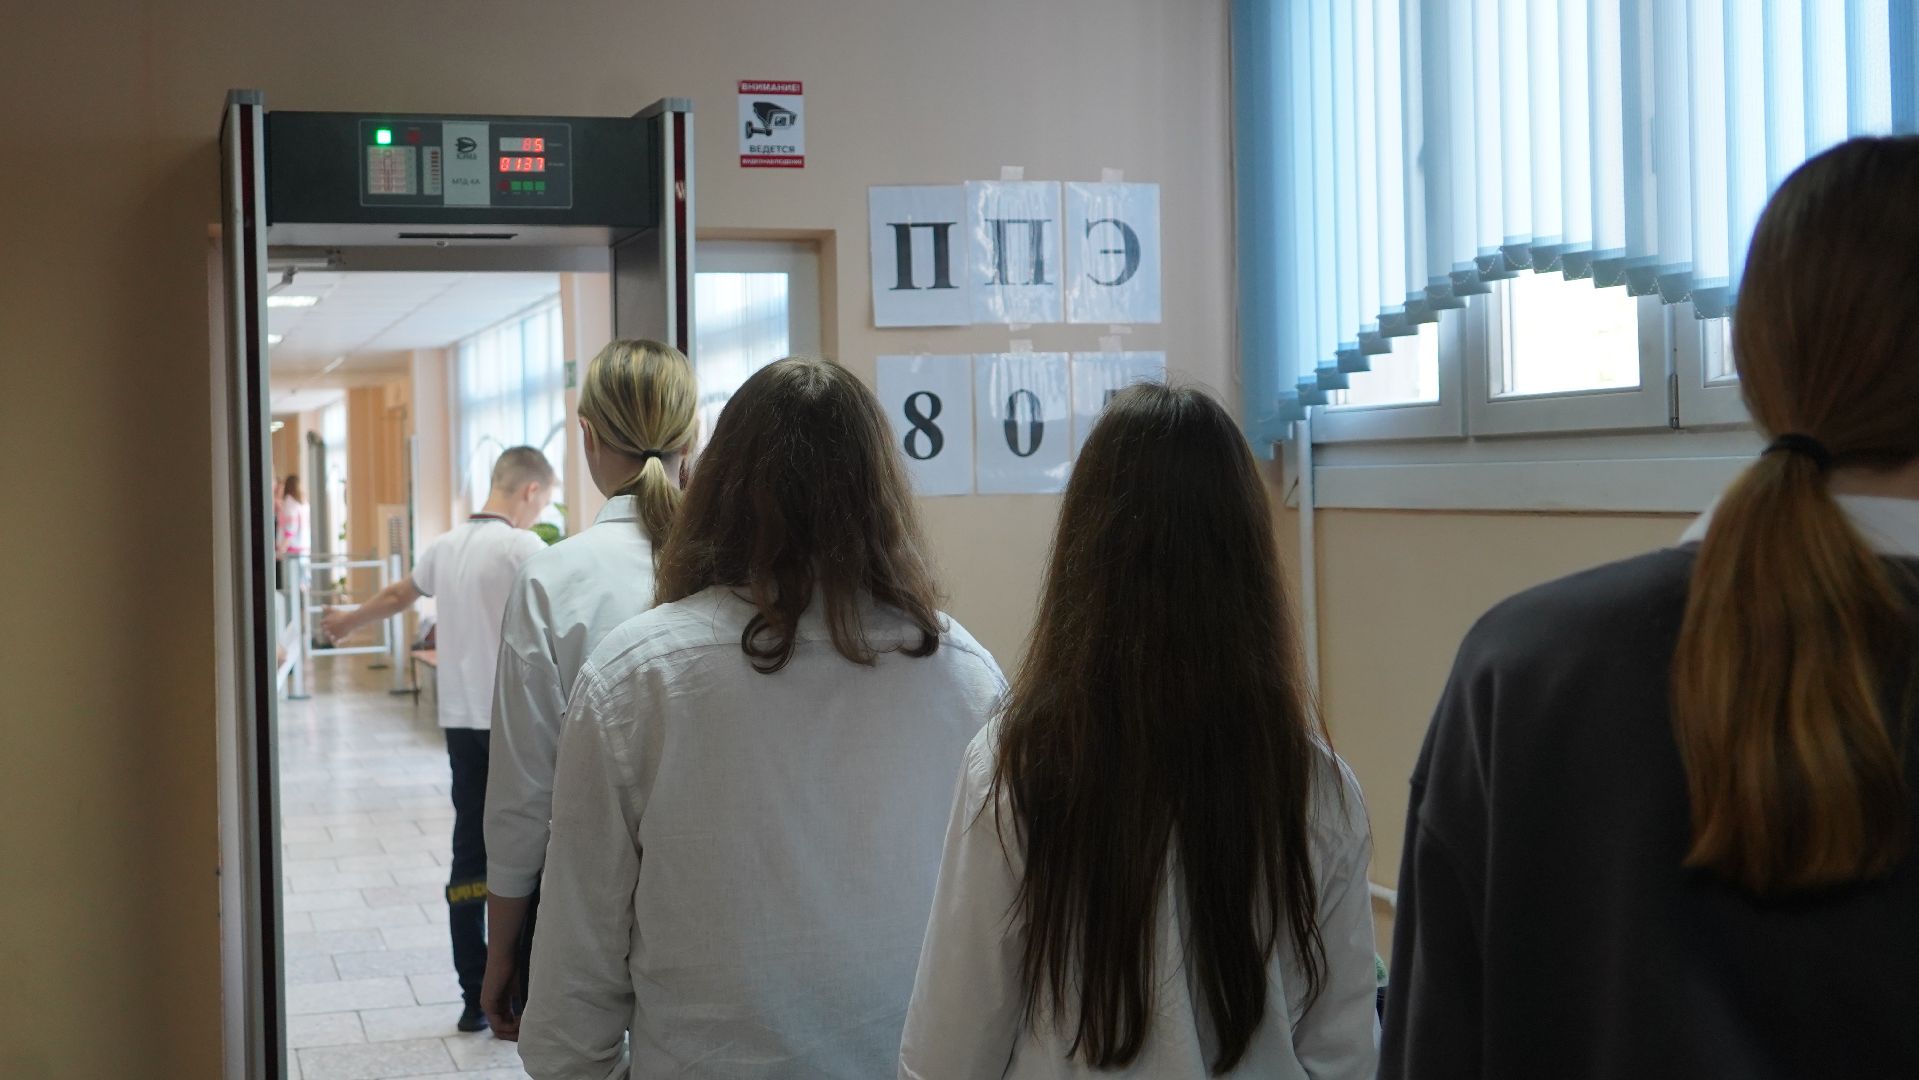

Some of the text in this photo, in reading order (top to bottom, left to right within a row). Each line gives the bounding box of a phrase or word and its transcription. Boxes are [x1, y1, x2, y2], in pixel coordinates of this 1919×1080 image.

[741, 83, 801, 92] ВНИМАНИЕ!
[749, 145, 795, 153] ВЕДЕТСЯ
[499, 157, 545, 171] 0137
[886, 217, 1142, 291] П П Э
[903, 388, 1045, 460] 8 0
